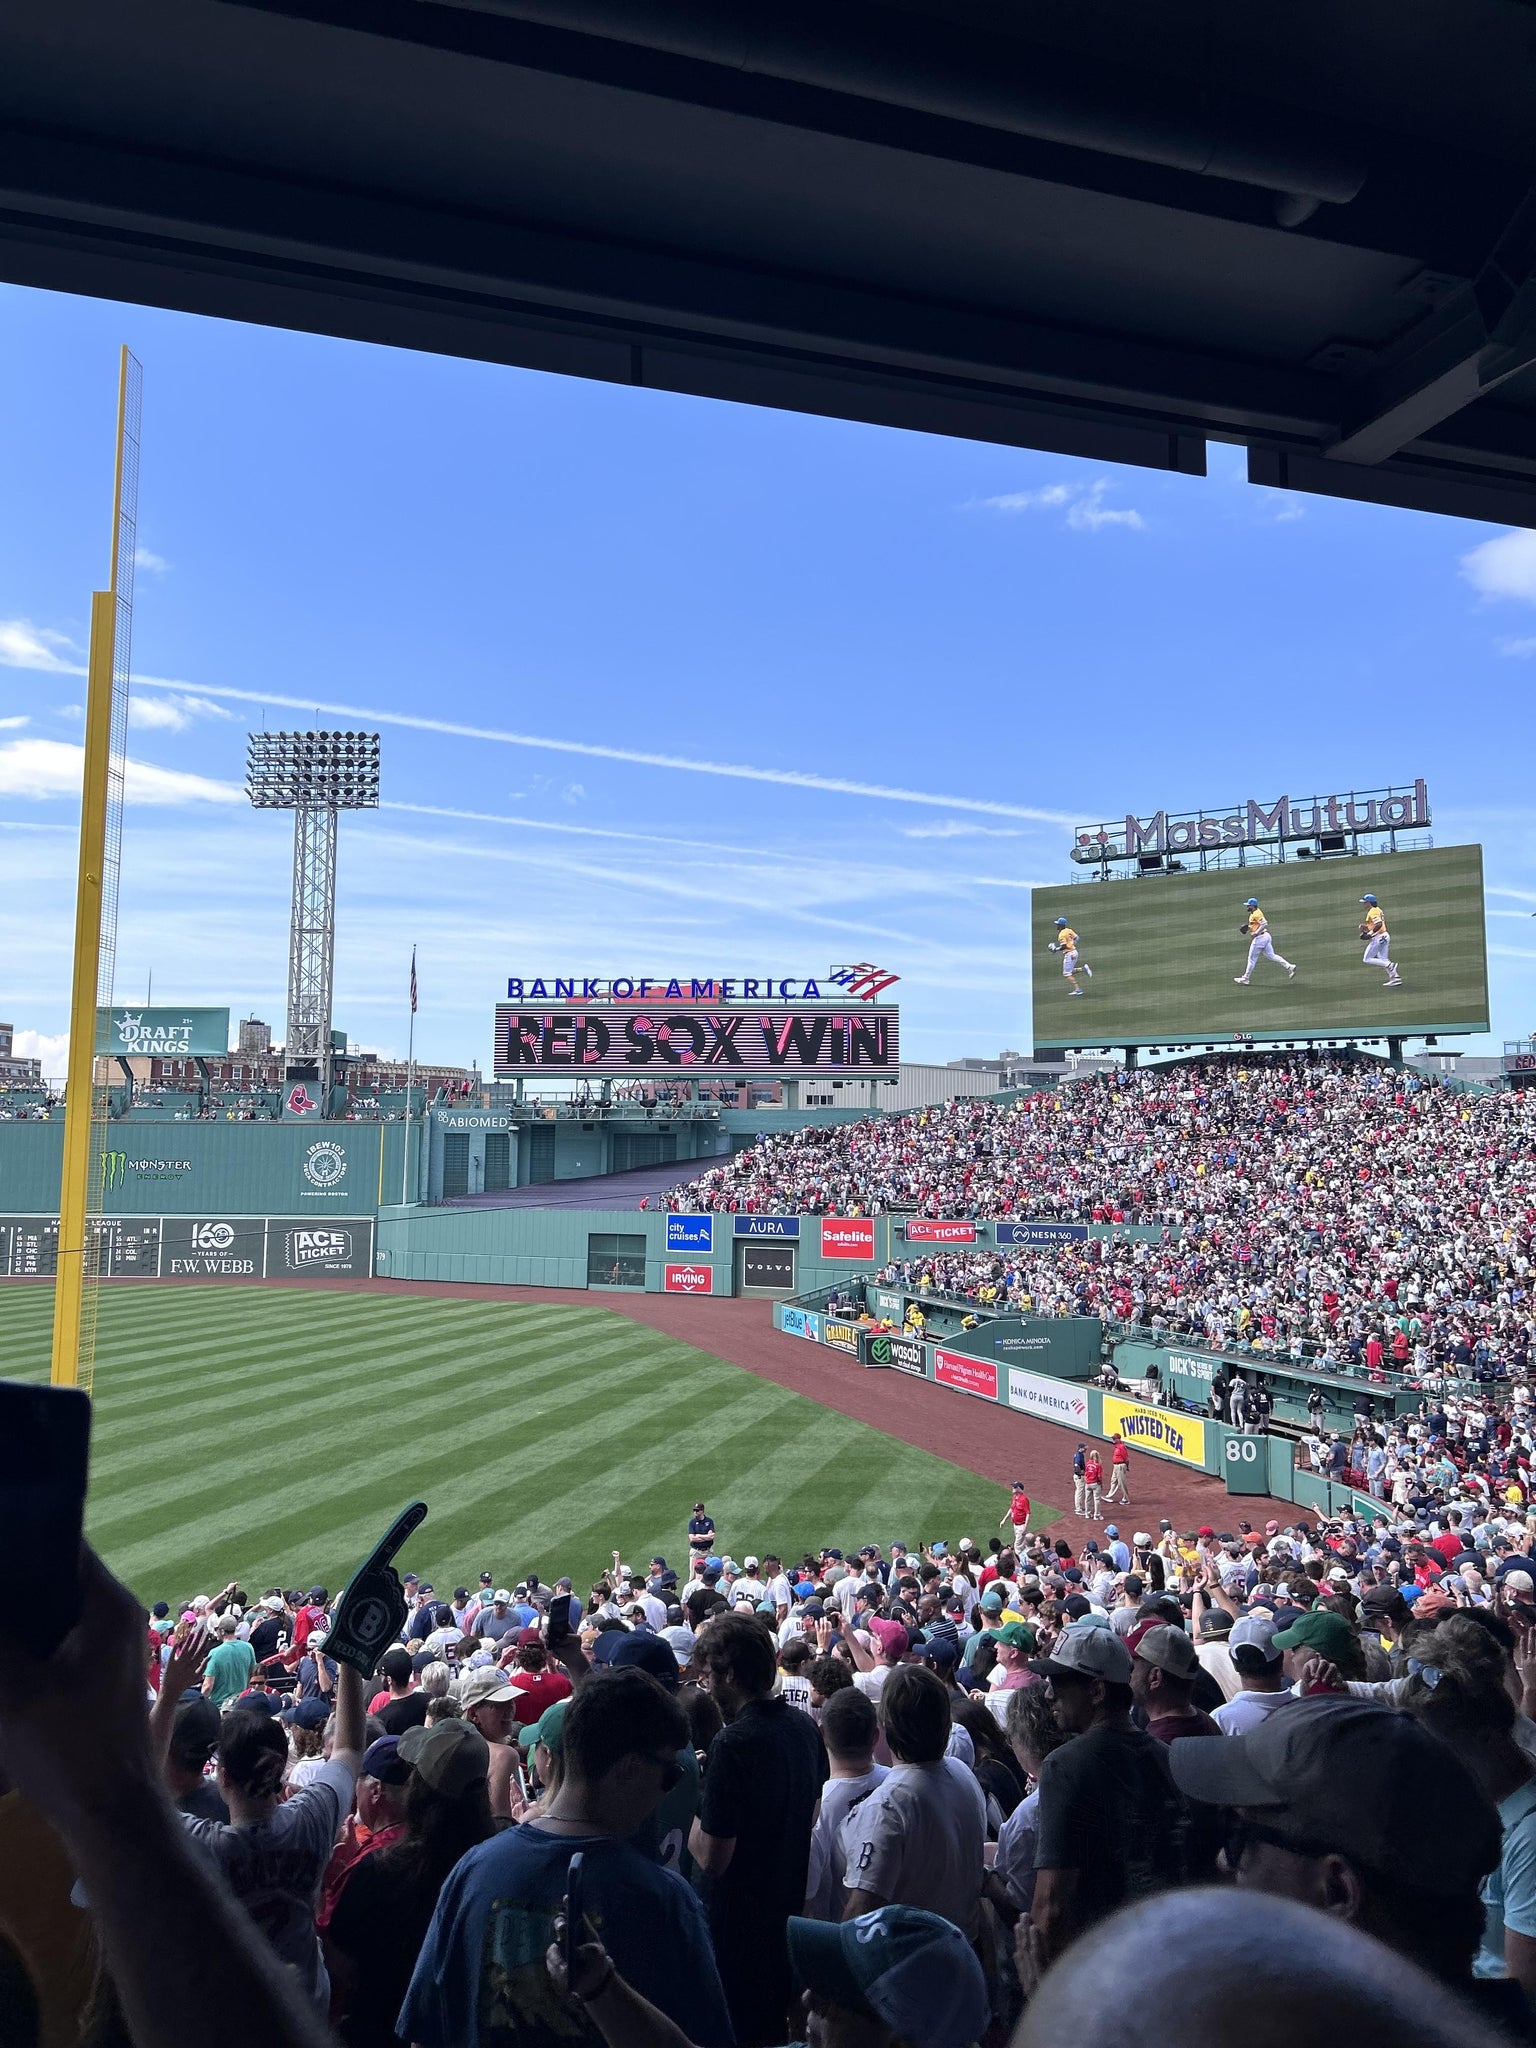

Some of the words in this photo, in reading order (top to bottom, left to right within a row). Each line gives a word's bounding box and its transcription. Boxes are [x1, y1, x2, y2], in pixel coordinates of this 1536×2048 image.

[1126, 779, 1427, 853] MassMutual
[507, 978, 600, 999] BANK
[613, 978, 654, 999] OF
[665, 978, 822, 999] AMERICA
[119, 1025, 193, 1042] DRAFT
[508, 1015, 609, 1064] RED
[625, 1015, 744, 1064] SOX
[758, 1015, 889, 1064] WIN
[127, 1040, 189, 1053] KINGS
[449, 1117, 508, 1127] ABIOMED
[306, 1141, 331, 1156] IBEW
[330, 1143, 346, 1156] 103
[128, 1159, 192, 1171] MONSTER
[191, 1222, 235, 1249] 160
[669, 1223, 685, 1233] city
[823, 1230, 873, 1242] Safelite
[911, 1224, 932, 1236] ACE
[934, 1226, 974, 1239] TICKET
[1031, 1231, 1057, 1239] NESN
[1058, 1231, 1072, 1240] 360
[298, 1231, 345, 1249] ACE
[669, 1232, 699, 1241] cruises
[300, 1246, 345, 1259] TICKET
[170, 1260, 200, 1274] F.W.
[204, 1259, 254, 1274] WEBB
[747, 1263, 791, 1271] VOLVO
[671, 1273, 705, 1284] IRVING
[784, 1308, 803, 1330] jetBlue
[826, 1323, 850, 1342] GRANITE
[891, 1343, 921, 1364] wasabi
[1169, 1355, 1197, 1377] DICK'S
[1010, 1385, 1028, 1400] BANK
[1028, 1390, 1037, 1401] OF
[1038, 1392, 1070, 1411] AMERICA
[1120, 1415, 1163, 1440] TWISTED
[1164, 1423, 1184, 1456] TEA
[1226, 1440, 1257, 1462] 80
[782, 1689, 808, 1703] ETER
[856, 1841, 875, 1871] B
